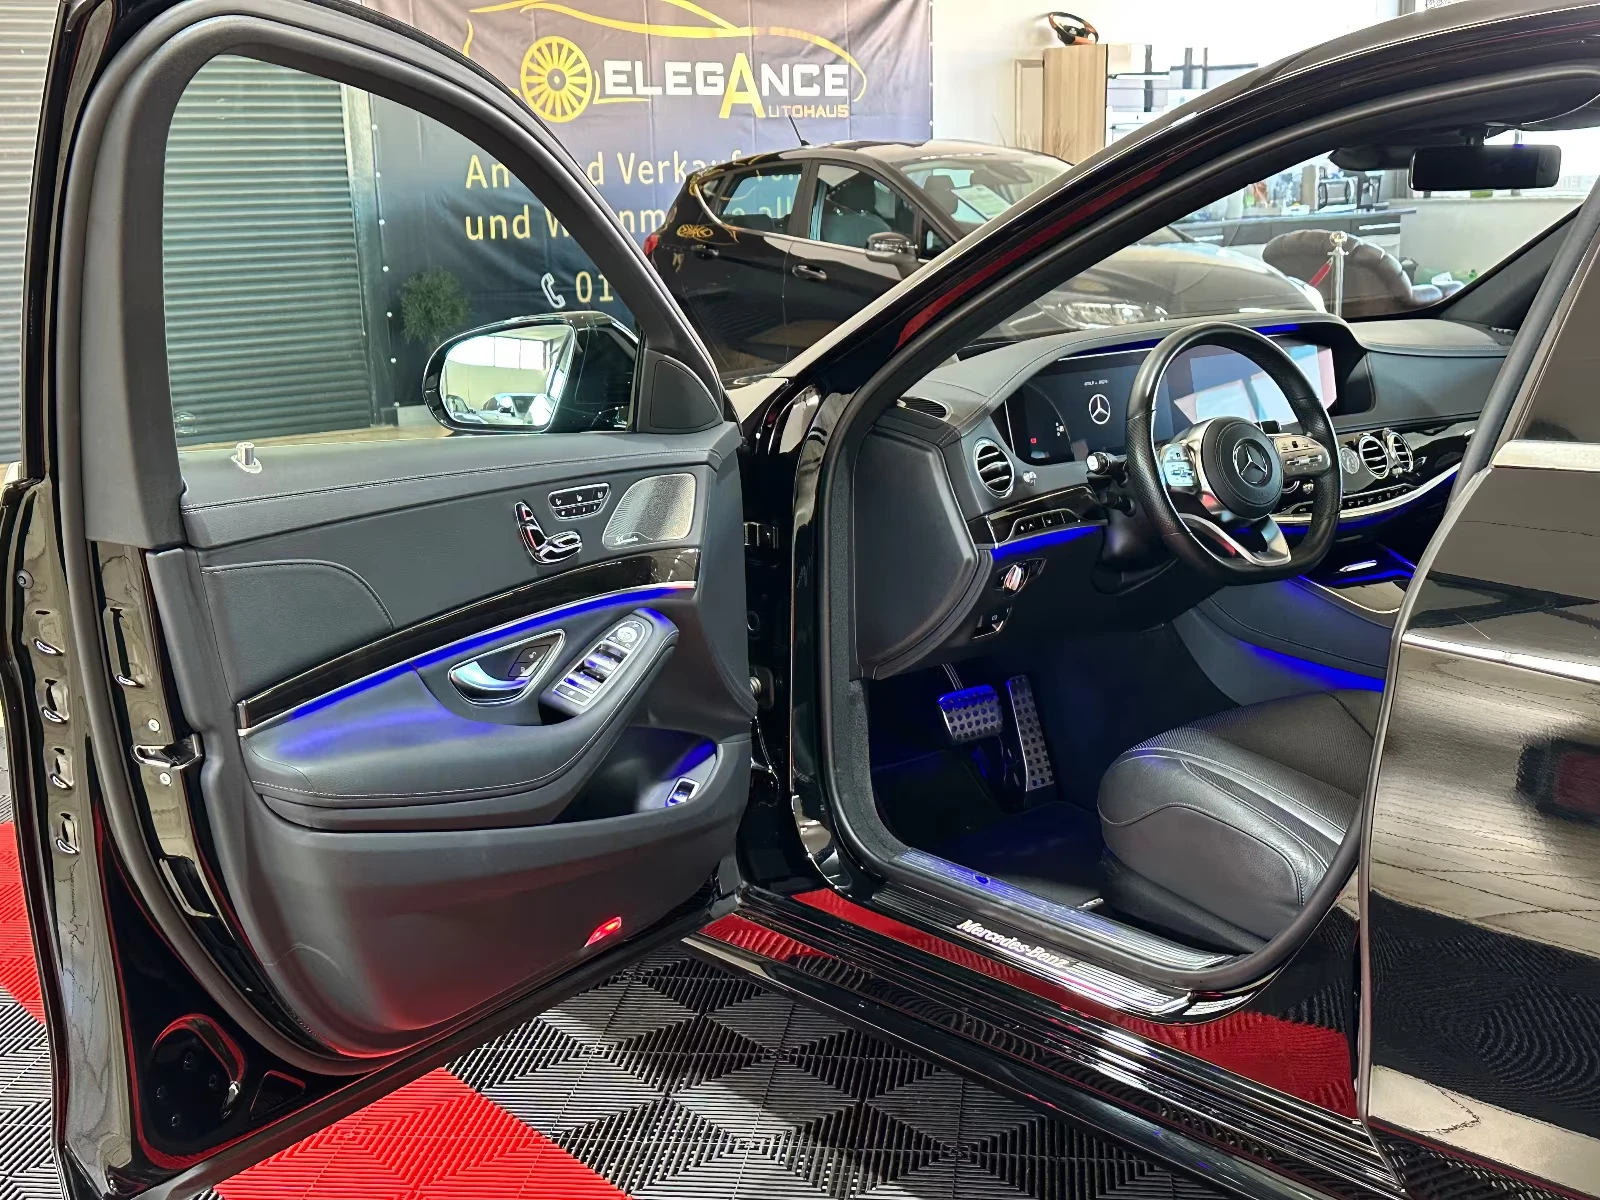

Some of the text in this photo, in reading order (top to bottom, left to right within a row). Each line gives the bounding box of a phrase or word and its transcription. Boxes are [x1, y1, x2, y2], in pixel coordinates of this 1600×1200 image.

[603, 53, 849, 119] ELEGANCE
[617, 150, 743, 184] Verk
[465, 204, 531, 240] und
[956, 919, 1070, 968] Mercedes-Benz
